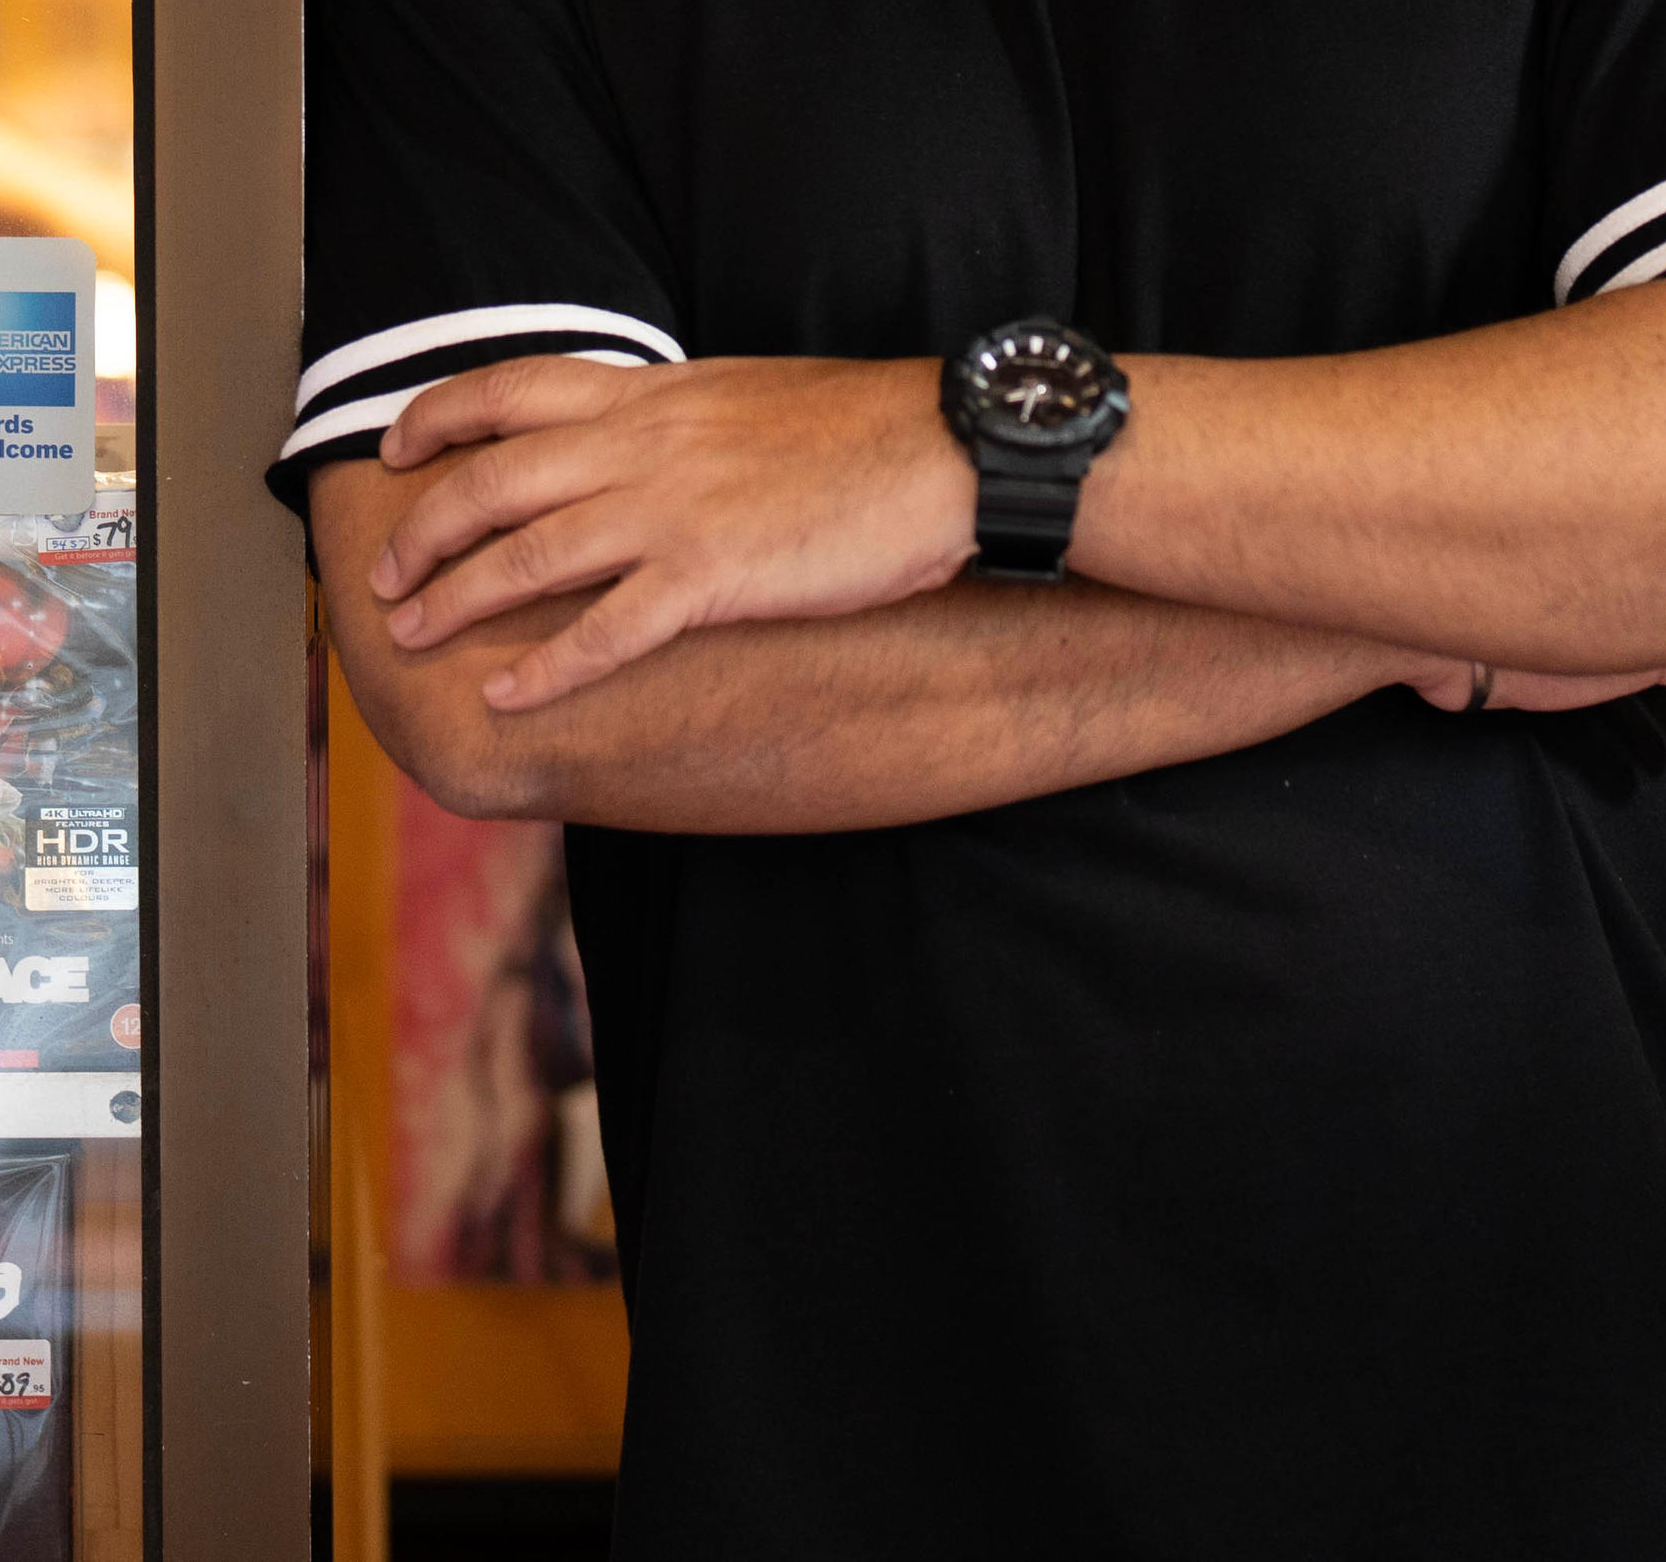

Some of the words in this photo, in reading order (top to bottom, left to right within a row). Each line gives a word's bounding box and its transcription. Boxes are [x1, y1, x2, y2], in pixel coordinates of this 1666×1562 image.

[89, 510, 118, 519] Brand
[122, 509, 136, 517] Ne
[44, 810, 63, 818] 4K
[37, 829, 130, 854] HDR
[37, 856, 57, 866] HIGH
[61, 856, 99, 866] DYNAMIC
[103, 855, 130, 865] RANGE
[121, 1018, 141, 1035] 12
[23, 1357, 44, 1366] New
